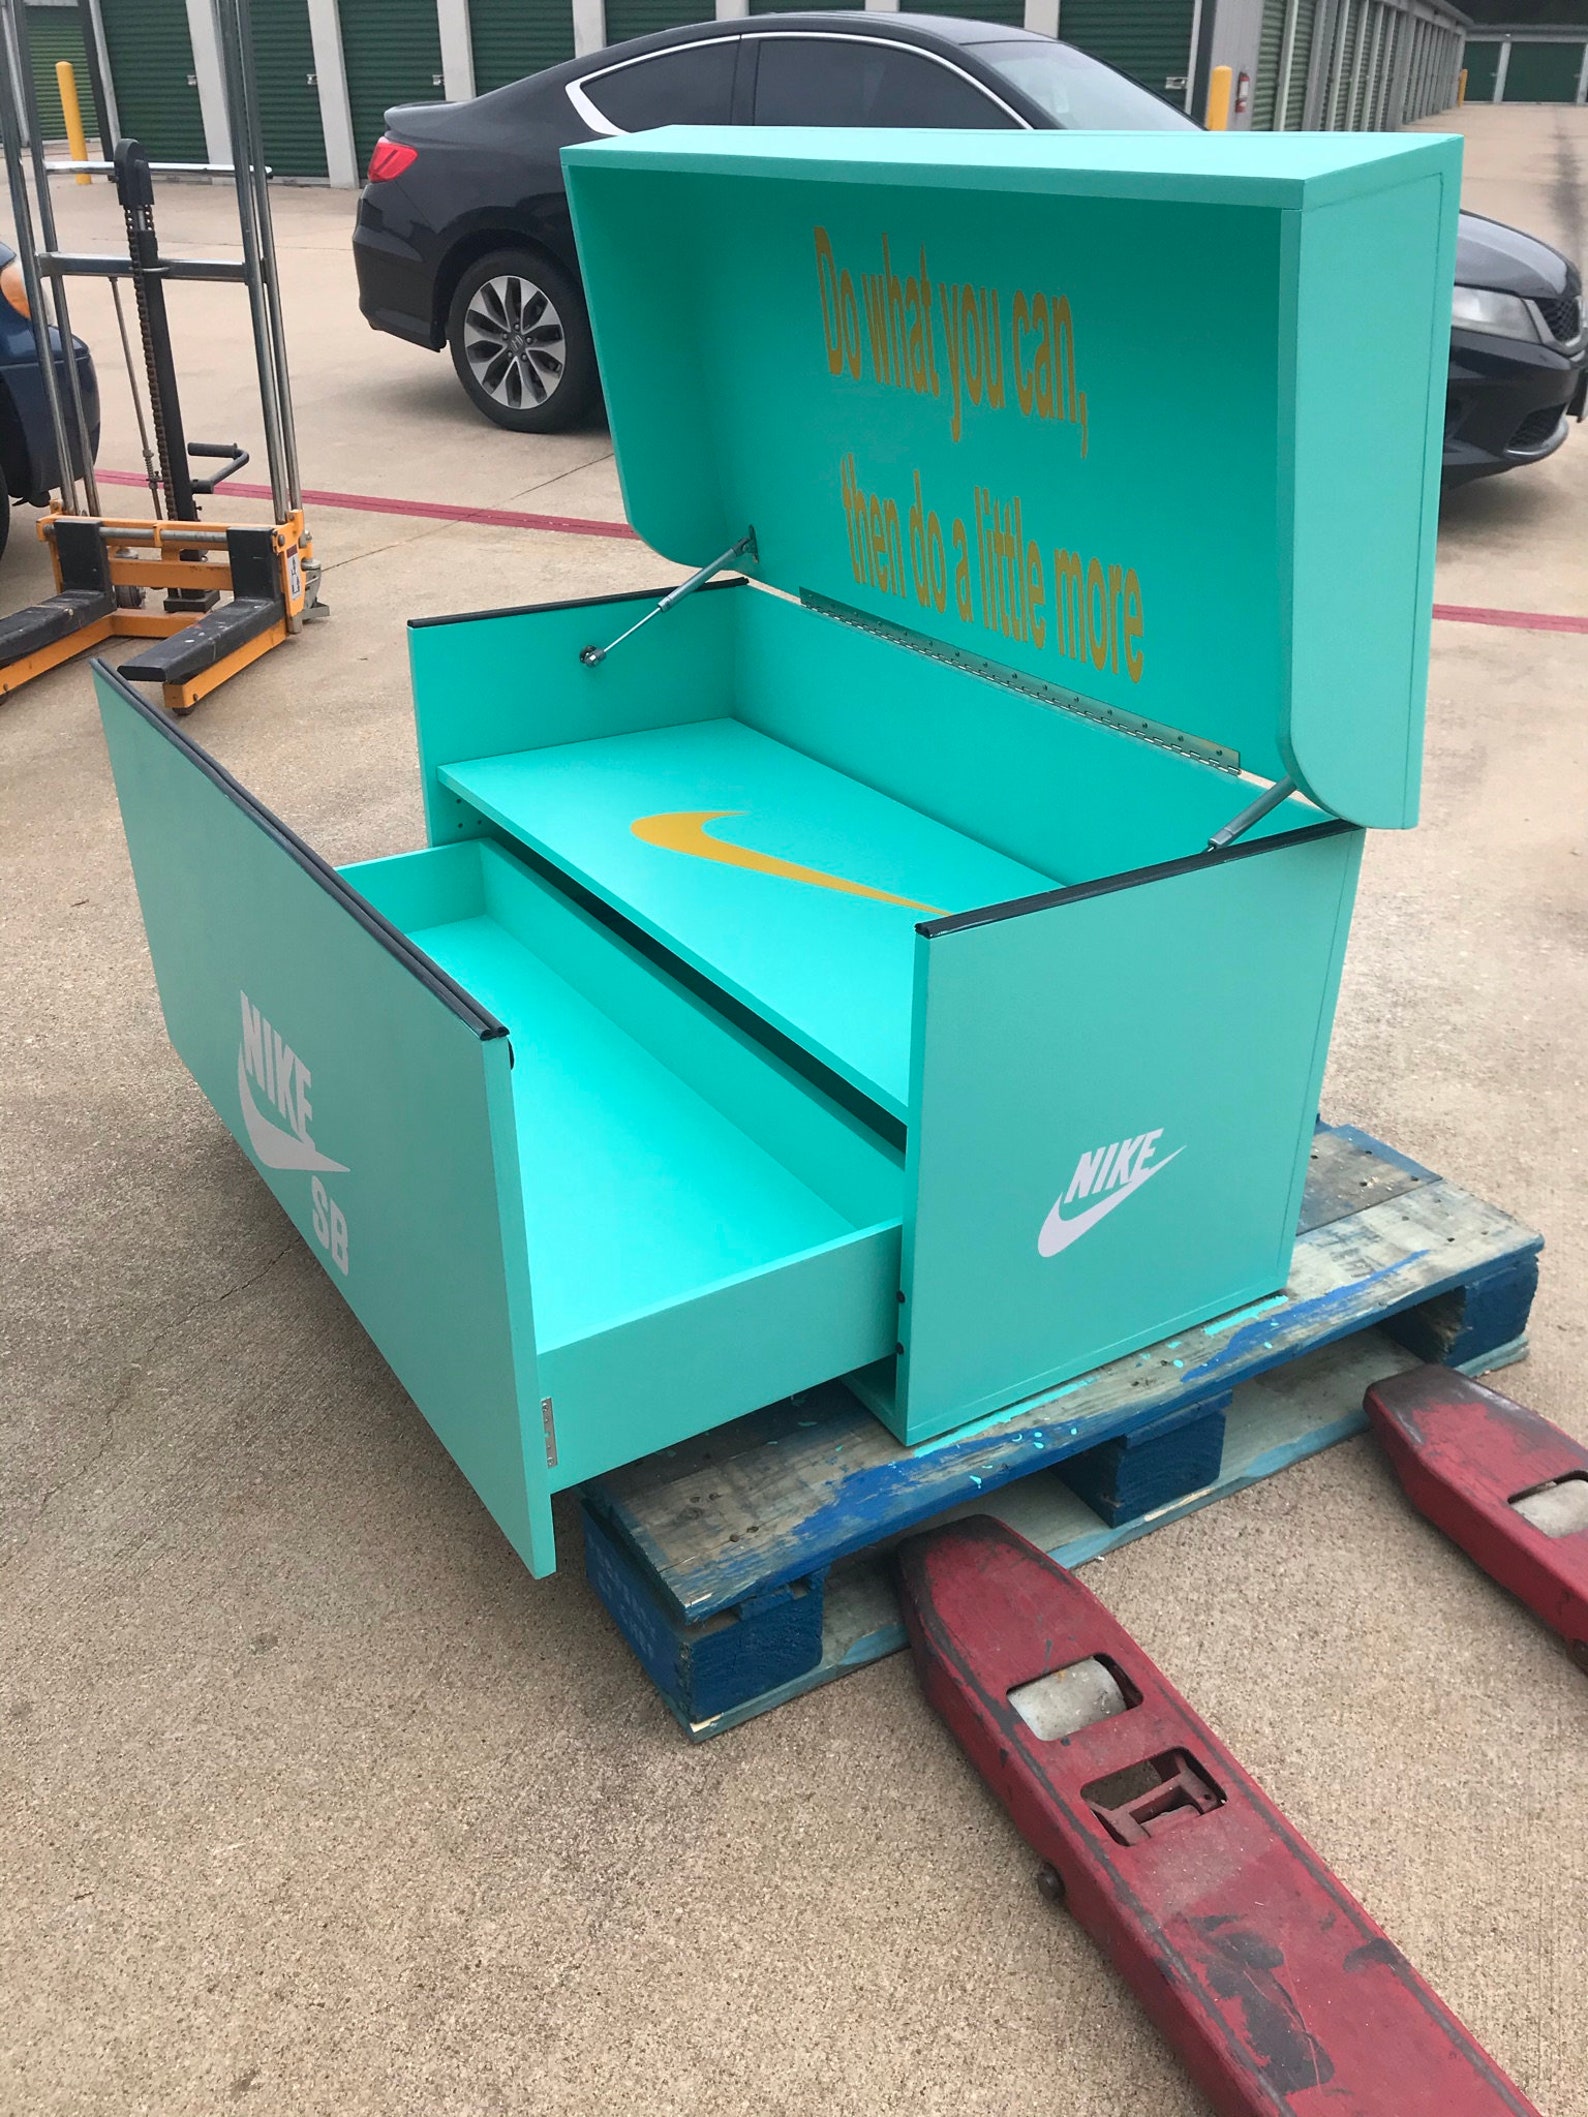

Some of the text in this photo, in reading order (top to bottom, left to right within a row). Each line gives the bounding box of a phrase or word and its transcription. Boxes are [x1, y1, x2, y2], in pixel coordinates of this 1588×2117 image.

[814, 225, 1088, 460] Do what you can,
[841, 452, 1144, 684] then do a little more
[240, 989, 316, 1151] NIKE
[311, 1174, 349, 1277] SB
[1063, 1127, 1165, 1204] NIKE
